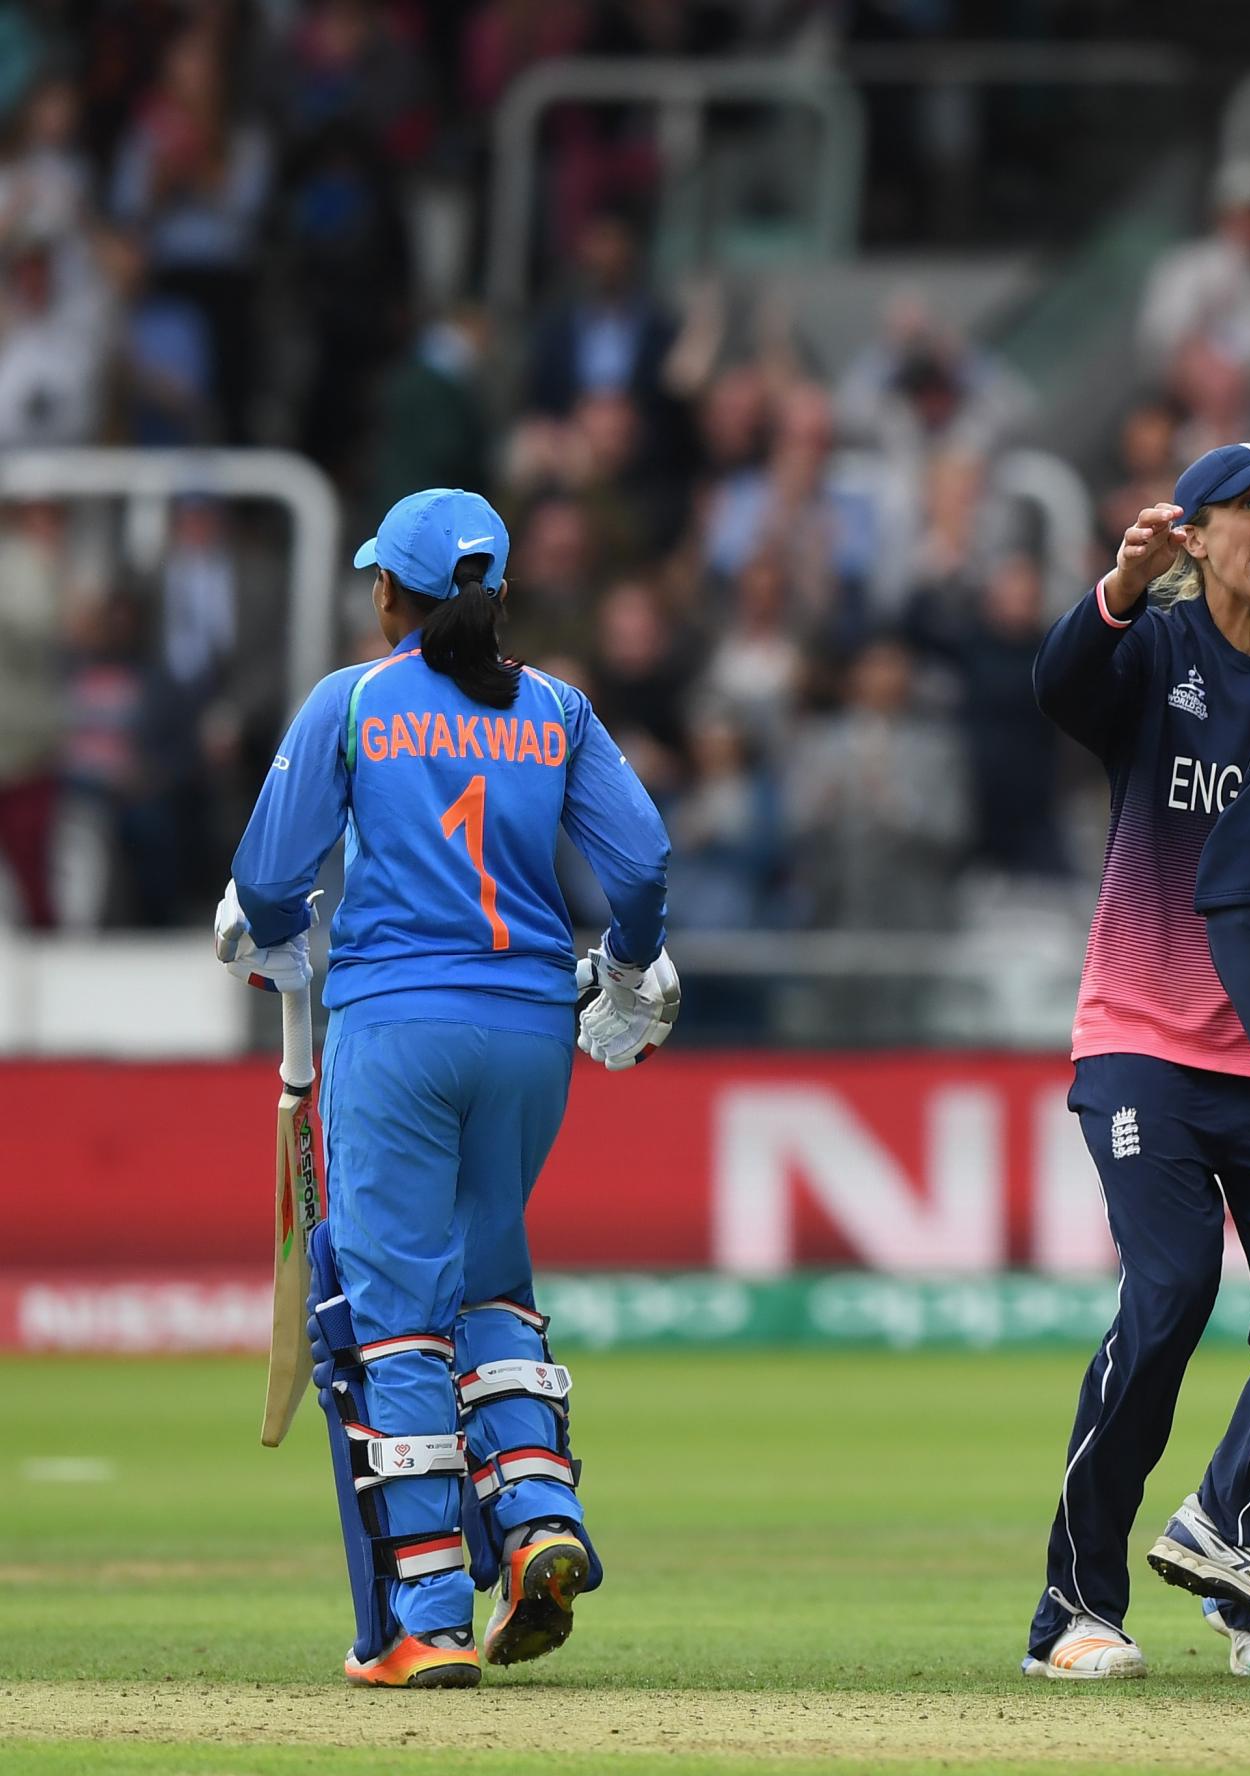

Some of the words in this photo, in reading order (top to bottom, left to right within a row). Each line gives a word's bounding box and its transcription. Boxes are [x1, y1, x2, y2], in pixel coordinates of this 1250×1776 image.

[1168, 694, 1195, 709] WORLD
[361, 711, 567, 767] GAYAKWAD
[440, 775, 510, 951] 1
[537, 1380, 554, 1390] V3
[393, 1457, 415, 1468] V3
